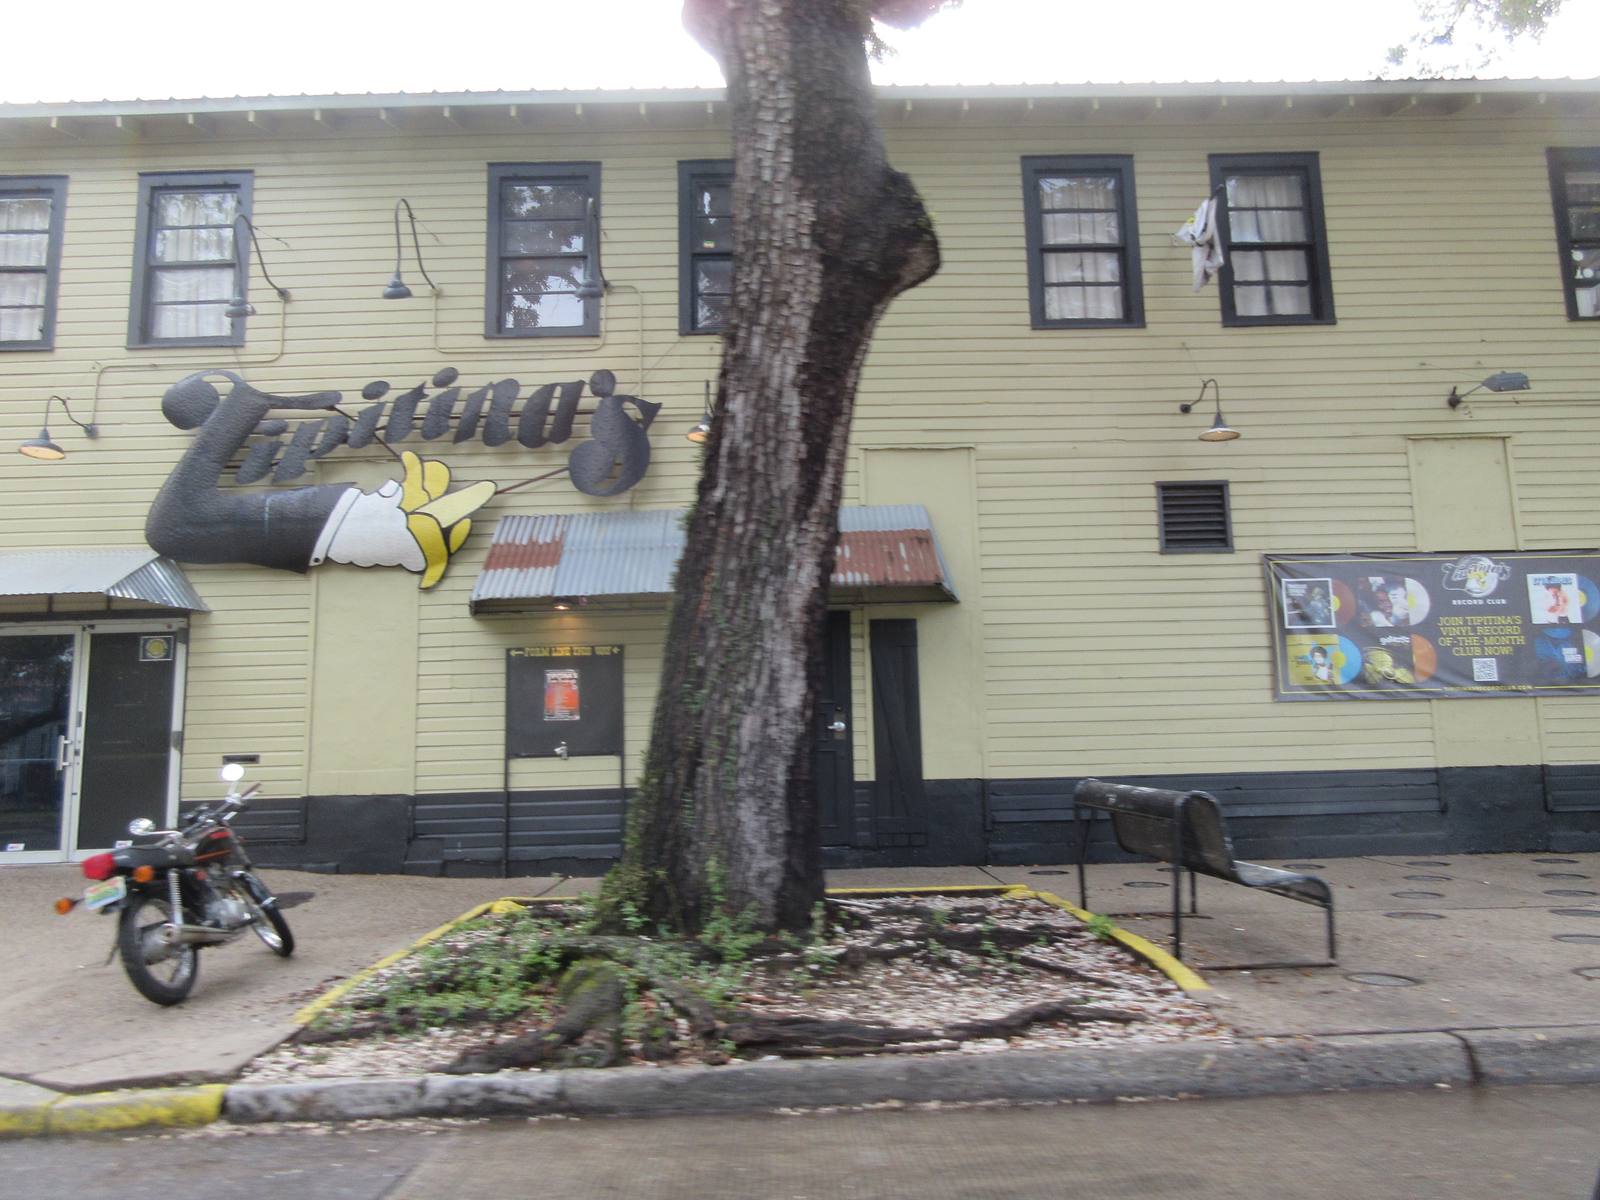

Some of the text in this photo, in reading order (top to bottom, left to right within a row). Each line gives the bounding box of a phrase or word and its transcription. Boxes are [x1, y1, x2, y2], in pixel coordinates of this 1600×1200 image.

[146, 366, 663, 573] Tipitina's
[1438, 615, 1521, 626] JOIN TIPITINA'S
[1440, 625, 1520, 636] VINYL RECORD
[1438, 635, 1525, 646] OF-THE-MONTH
[1452, 646, 1513, 656] CLUB NOW!
